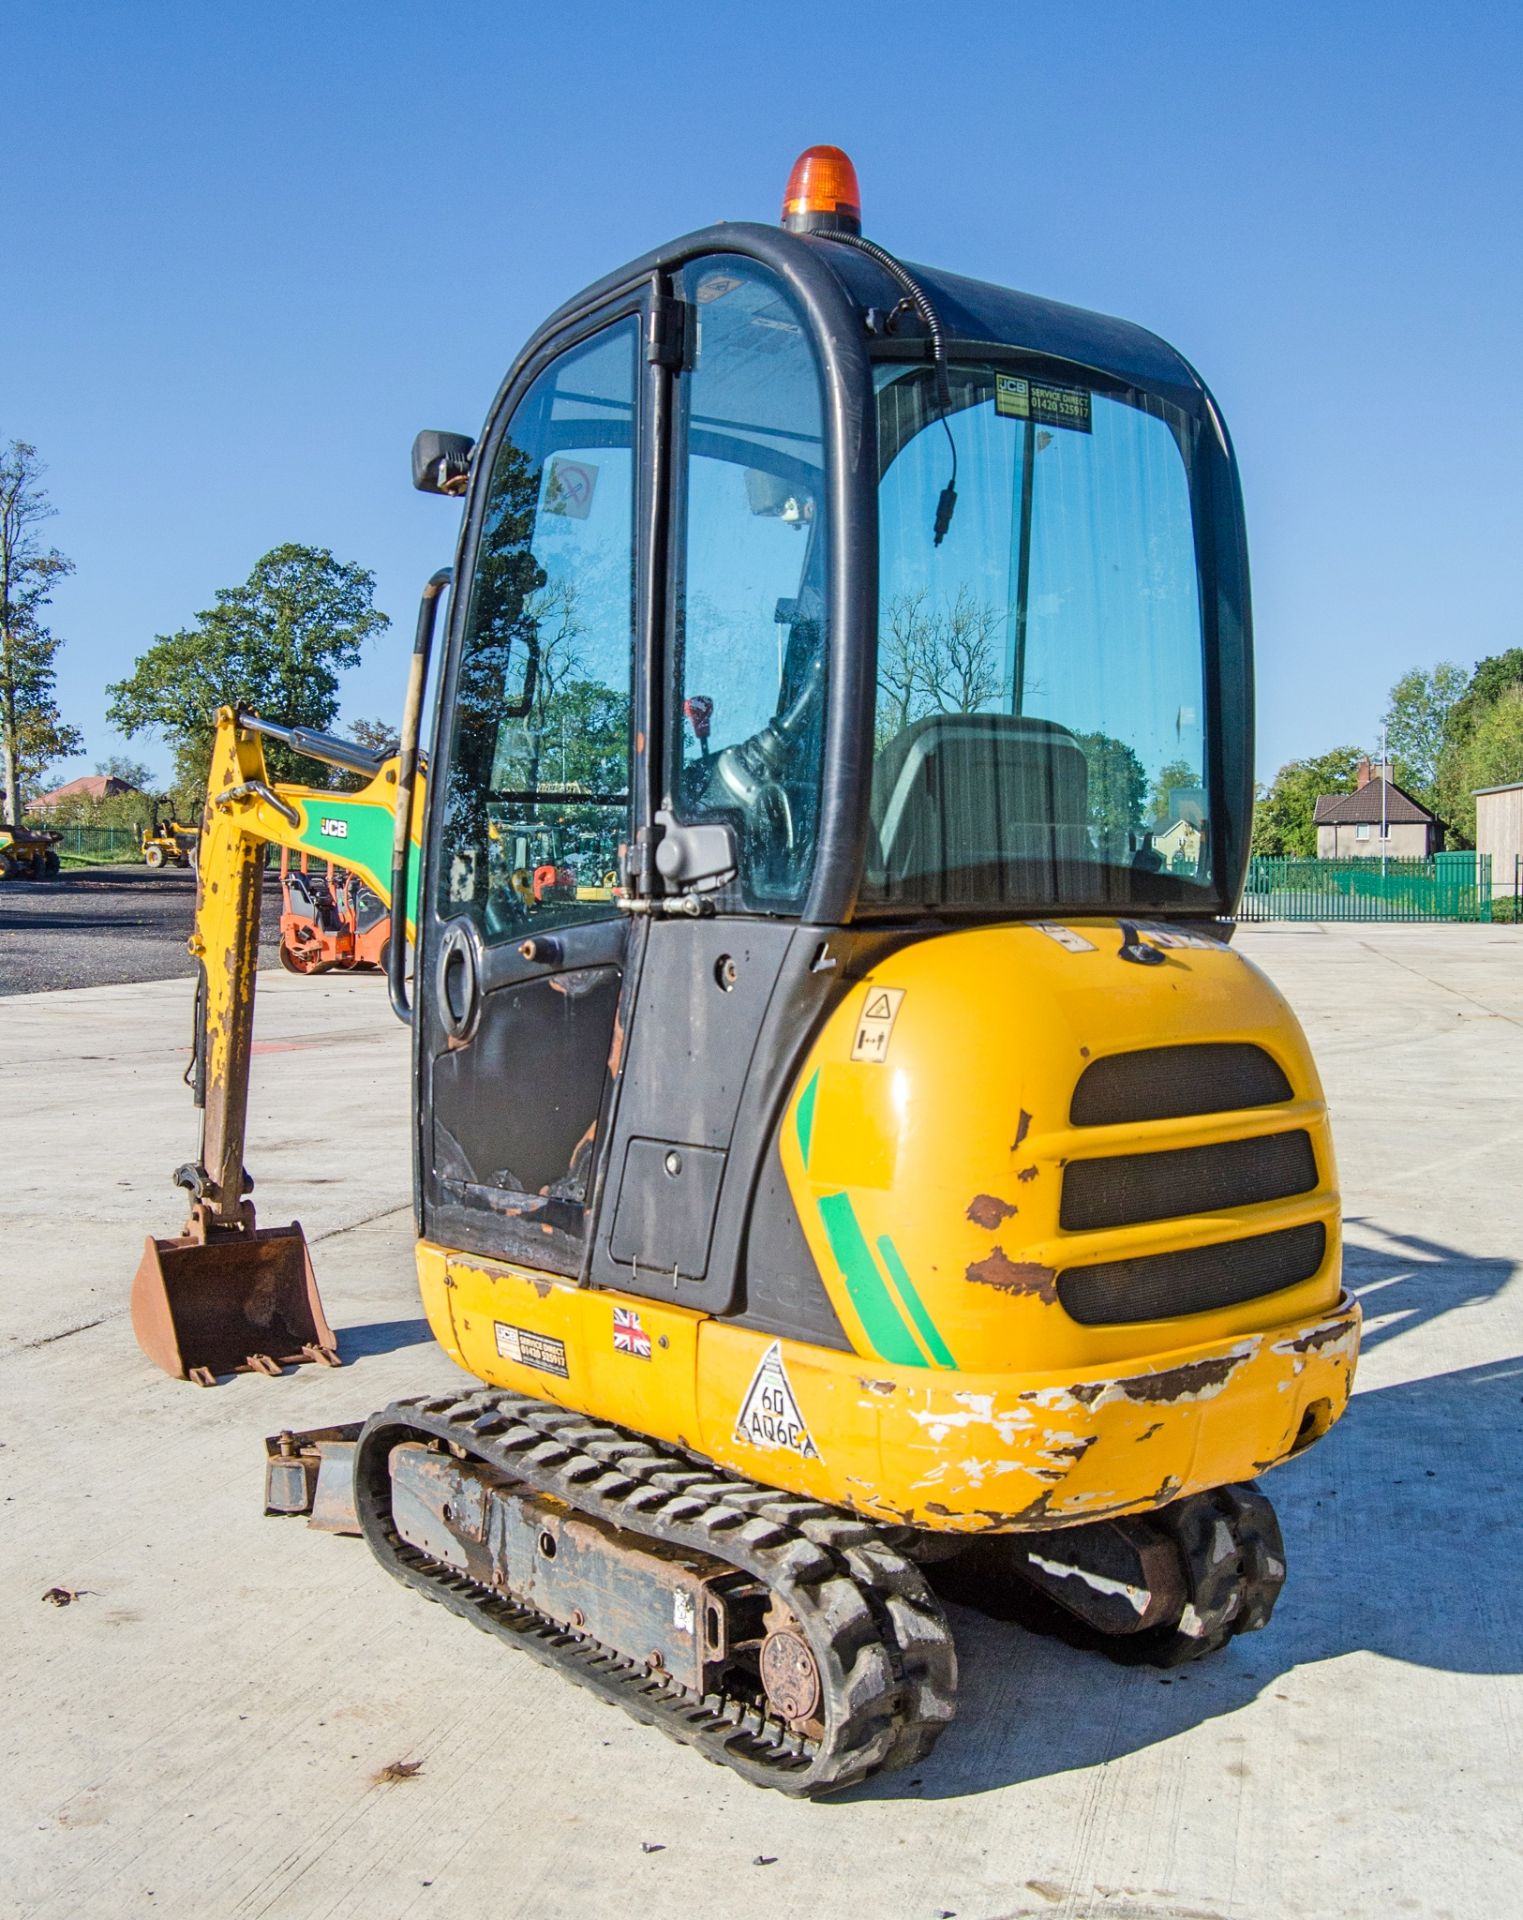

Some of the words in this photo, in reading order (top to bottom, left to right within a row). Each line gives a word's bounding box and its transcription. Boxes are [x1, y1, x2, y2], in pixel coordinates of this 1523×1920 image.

[1000, 379, 1026, 393] JCB
[1031, 387, 1061, 401] SERVICE
[1063, 394, 1088, 406] DIRECT
[1031, 397, 1057, 410] 01420
[1060, 403, 1088, 418] 525917
[321, 818, 347, 837] JCB
